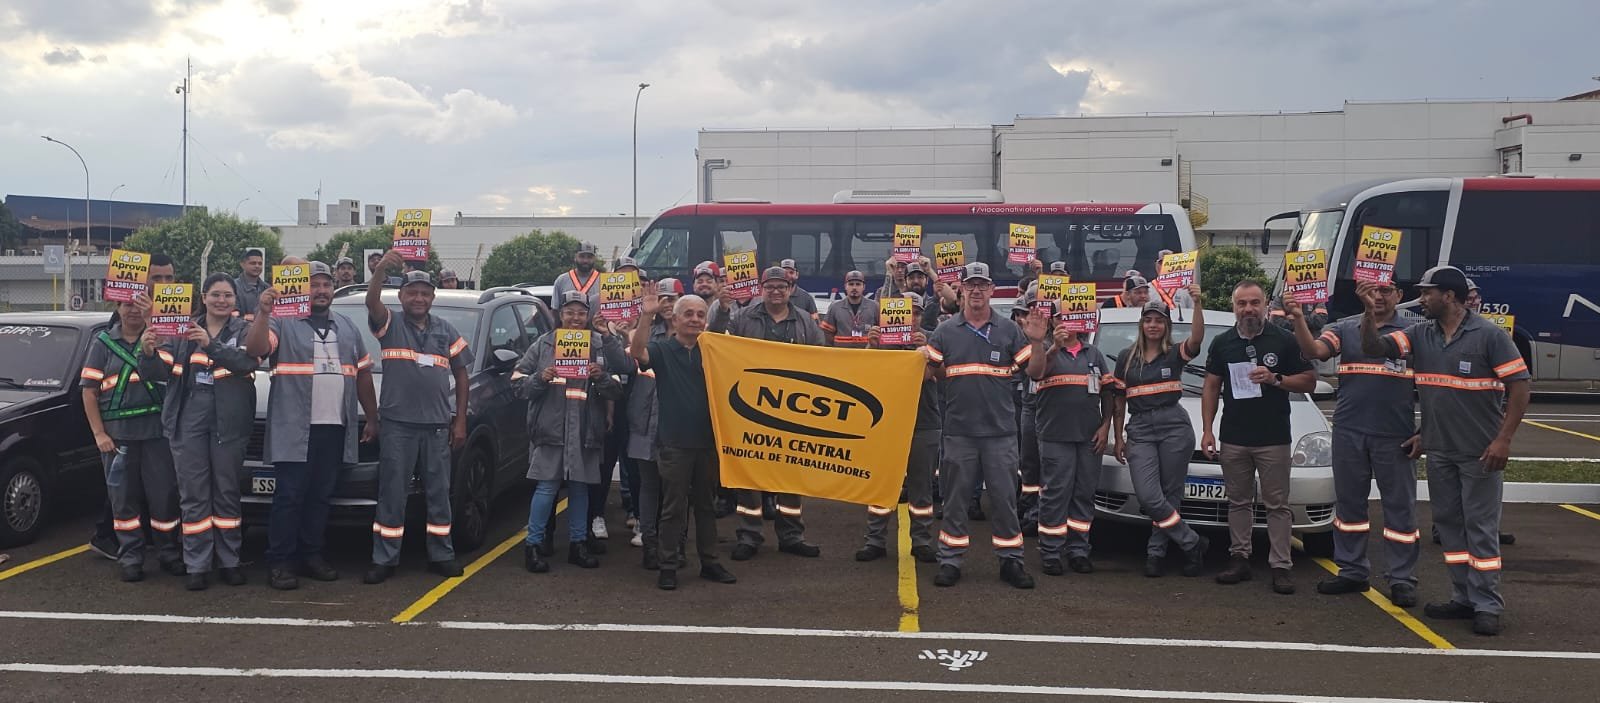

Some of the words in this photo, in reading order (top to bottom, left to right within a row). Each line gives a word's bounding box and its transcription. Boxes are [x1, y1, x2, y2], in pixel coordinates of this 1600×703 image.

[397, 220, 428, 228] Aprova
[400, 228, 420, 237] JÁ!
[1010, 232, 1034, 240] Aprova
[1016, 239, 1030, 247] JÁ!
[1362, 238, 1397, 250] Aprova
[936, 250, 962, 258] Aprova
[1366, 249, 1388, 262] JÁ!
[112, 260, 147, 272] Aprova
[942, 257, 958, 266] JÁ!
[728, 263, 755, 272] Aprova
[1168, 264, 1187, 272] JÁ!
[1288, 263, 1324, 272] Aprova
[116, 270, 138, 281] JÁ!
[734, 270, 750, 280] JÁ!
[1296, 270, 1317, 282] JÁ!
[274, 276, 308, 285] Aprova
[280, 284, 302, 294] JÁ!
[607, 290, 624, 300] JÁ!
[1044, 291, 1061, 300] JÁ!
[1063, 294, 1095, 302] Aprova
[155, 295, 190, 305] Aprova
[160, 303, 182, 314] JÁ!
[1069, 302, 1088, 311] JÁ!
[882, 308, 911, 316] Aprova
[887, 315, 905, 324] JÁ!
[558, 340, 588, 348] Aprova
[563, 348, 582, 357] JÁ!
[756, 386, 856, 421] NCST
[742, 432, 783, 449] NOVA
[788, 439, 853, 462] CENTRAL
[722, 446, 765, 460] SINDICAL
[768, 454, 782, 462] DE
[785, 454, 872, 480] TRABALHADORES
